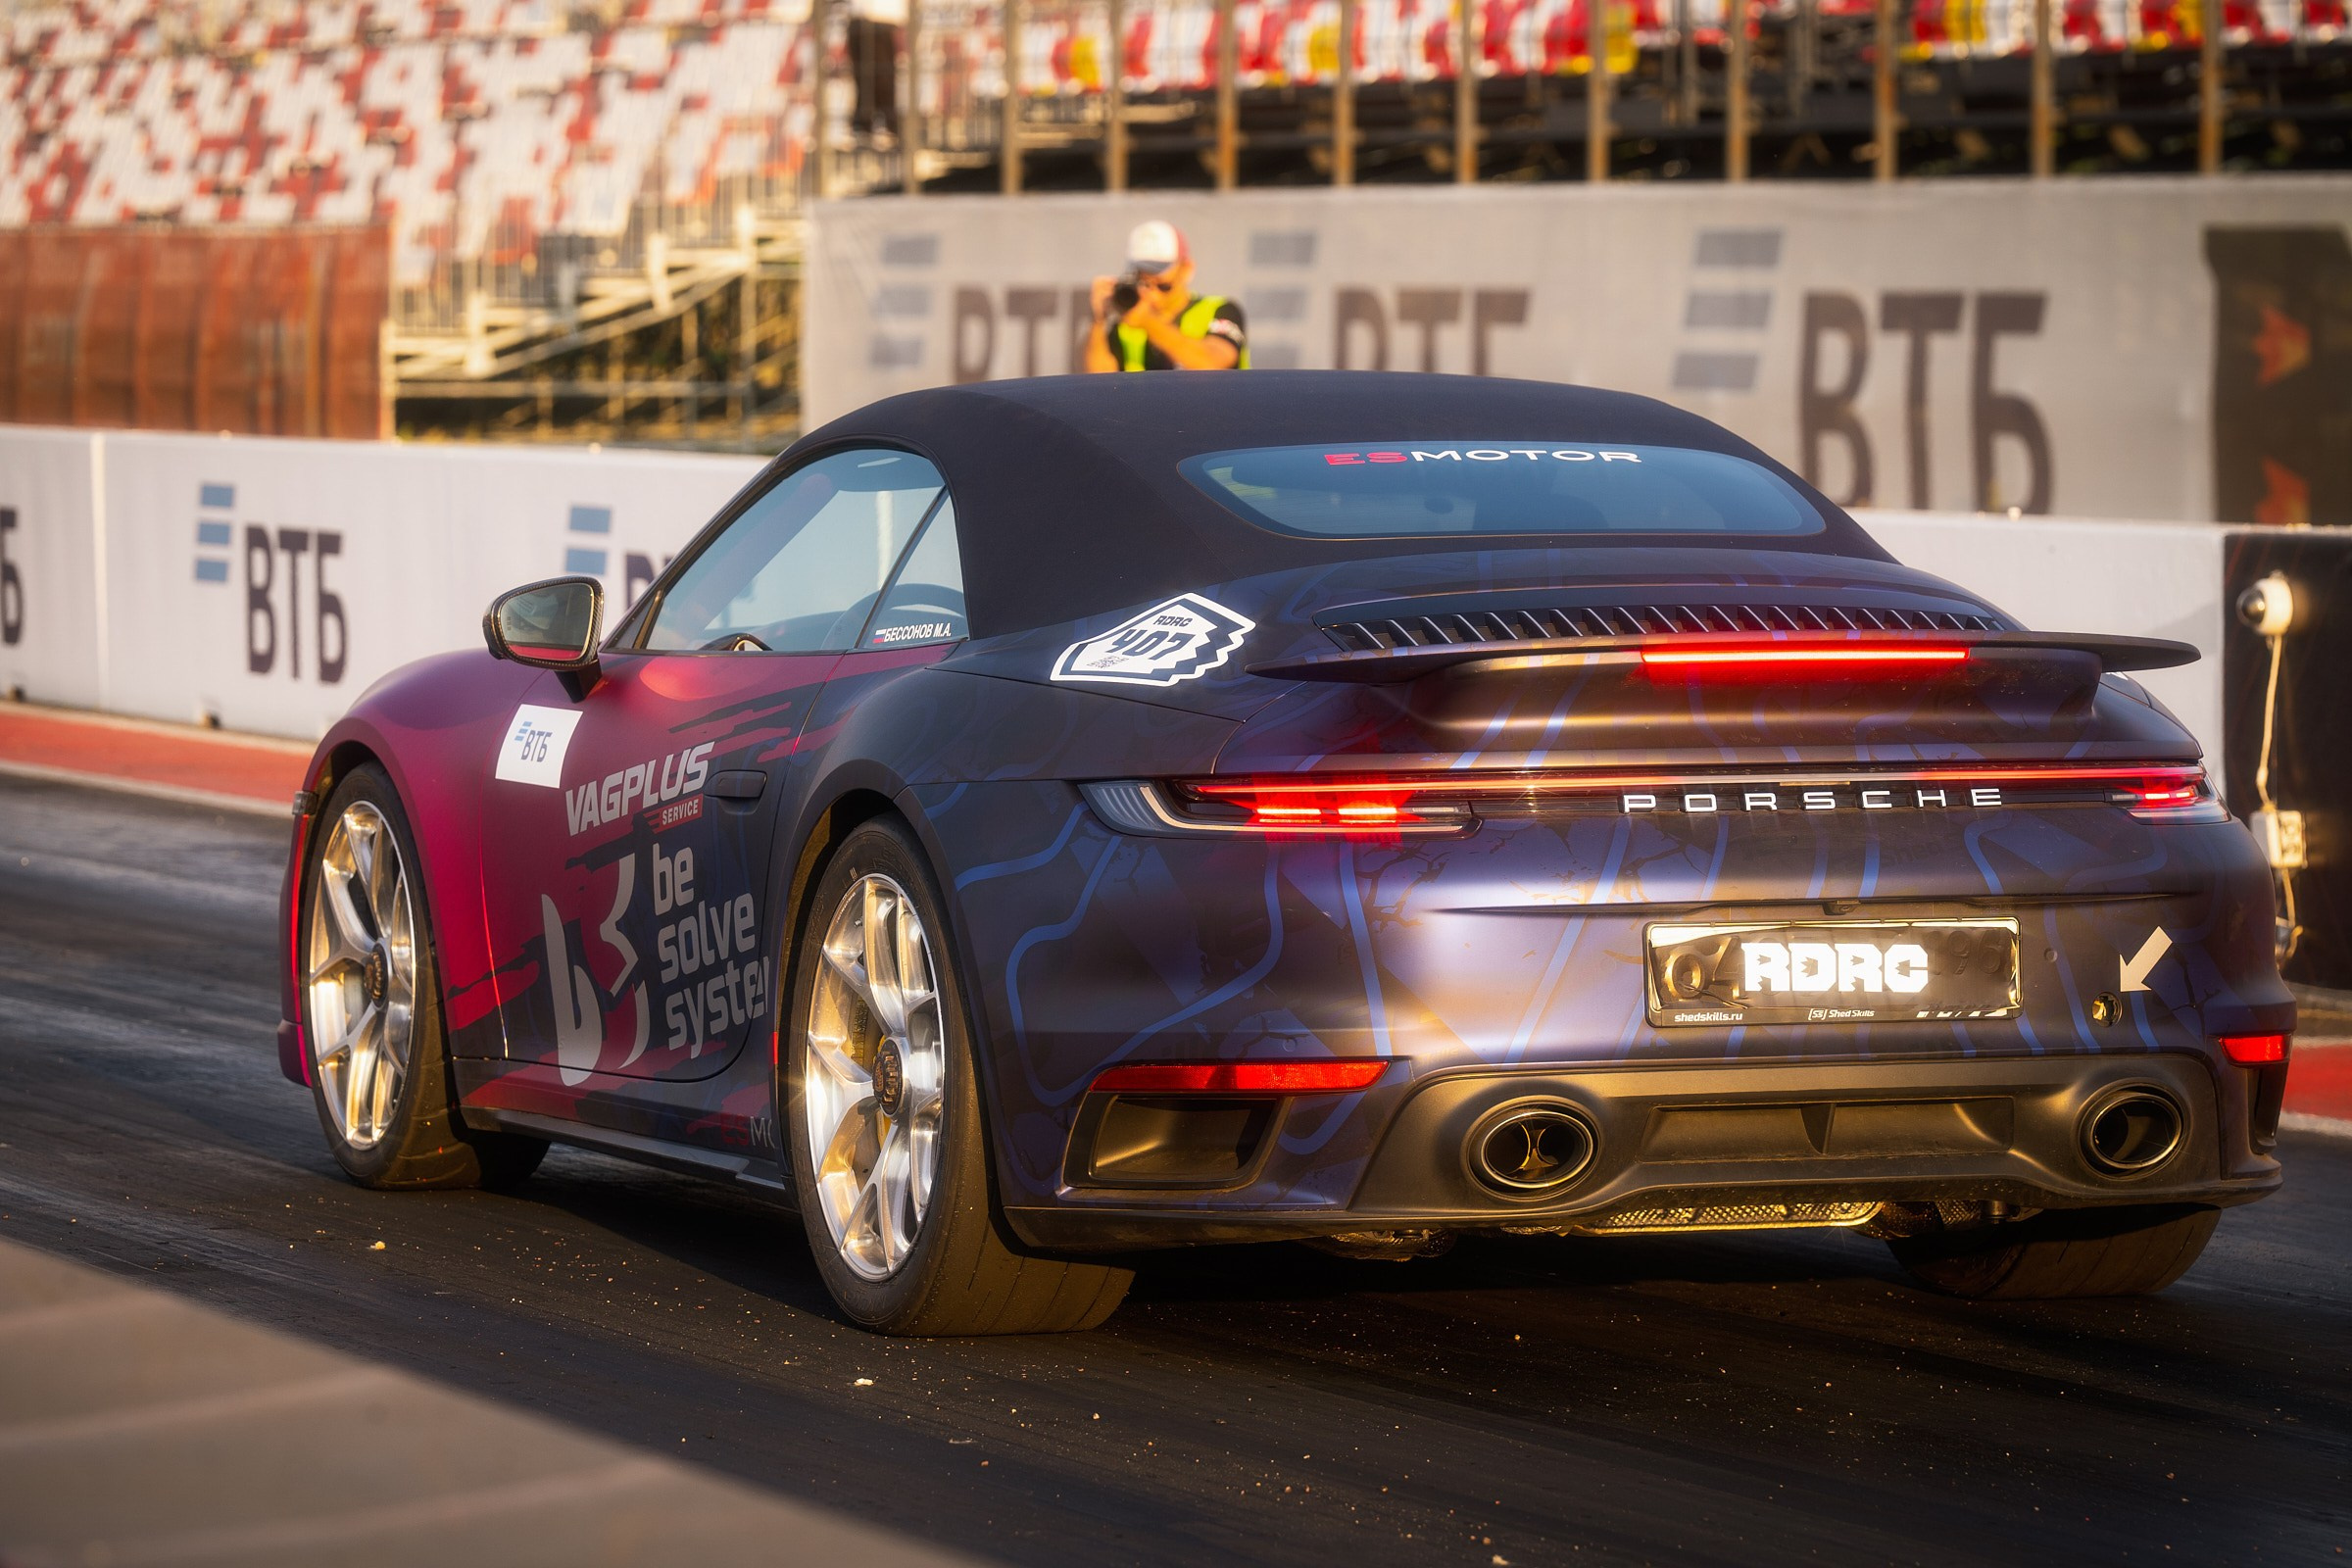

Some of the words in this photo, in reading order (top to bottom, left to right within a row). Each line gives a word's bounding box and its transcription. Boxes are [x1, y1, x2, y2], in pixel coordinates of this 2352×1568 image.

[1801, 290, 2052, 514] ВТБ
[1324, 449, 1642, 466] ESMOTOR
[245, 524, 347, 684] ВТБ
[883, 623, 934, 643] БЕССОНОВ
[1104, 628, 1196, 662] 407
[520, 729, 553, 763] ВТБ
[565, 741, 715, 837] VAGPLUS
[1623, 788, 2002, 813] PORSCHE
[662, 799, 699, 826] SERVICE
[652, 842, 695, 916] be
[657, 892, 757, 985] solve
[1740, 942, 1929, 994] RDRC
[1674, 1011, 1743, 1023] shedskills.ru
[1828, 1009, 1851, 1018] Shed
